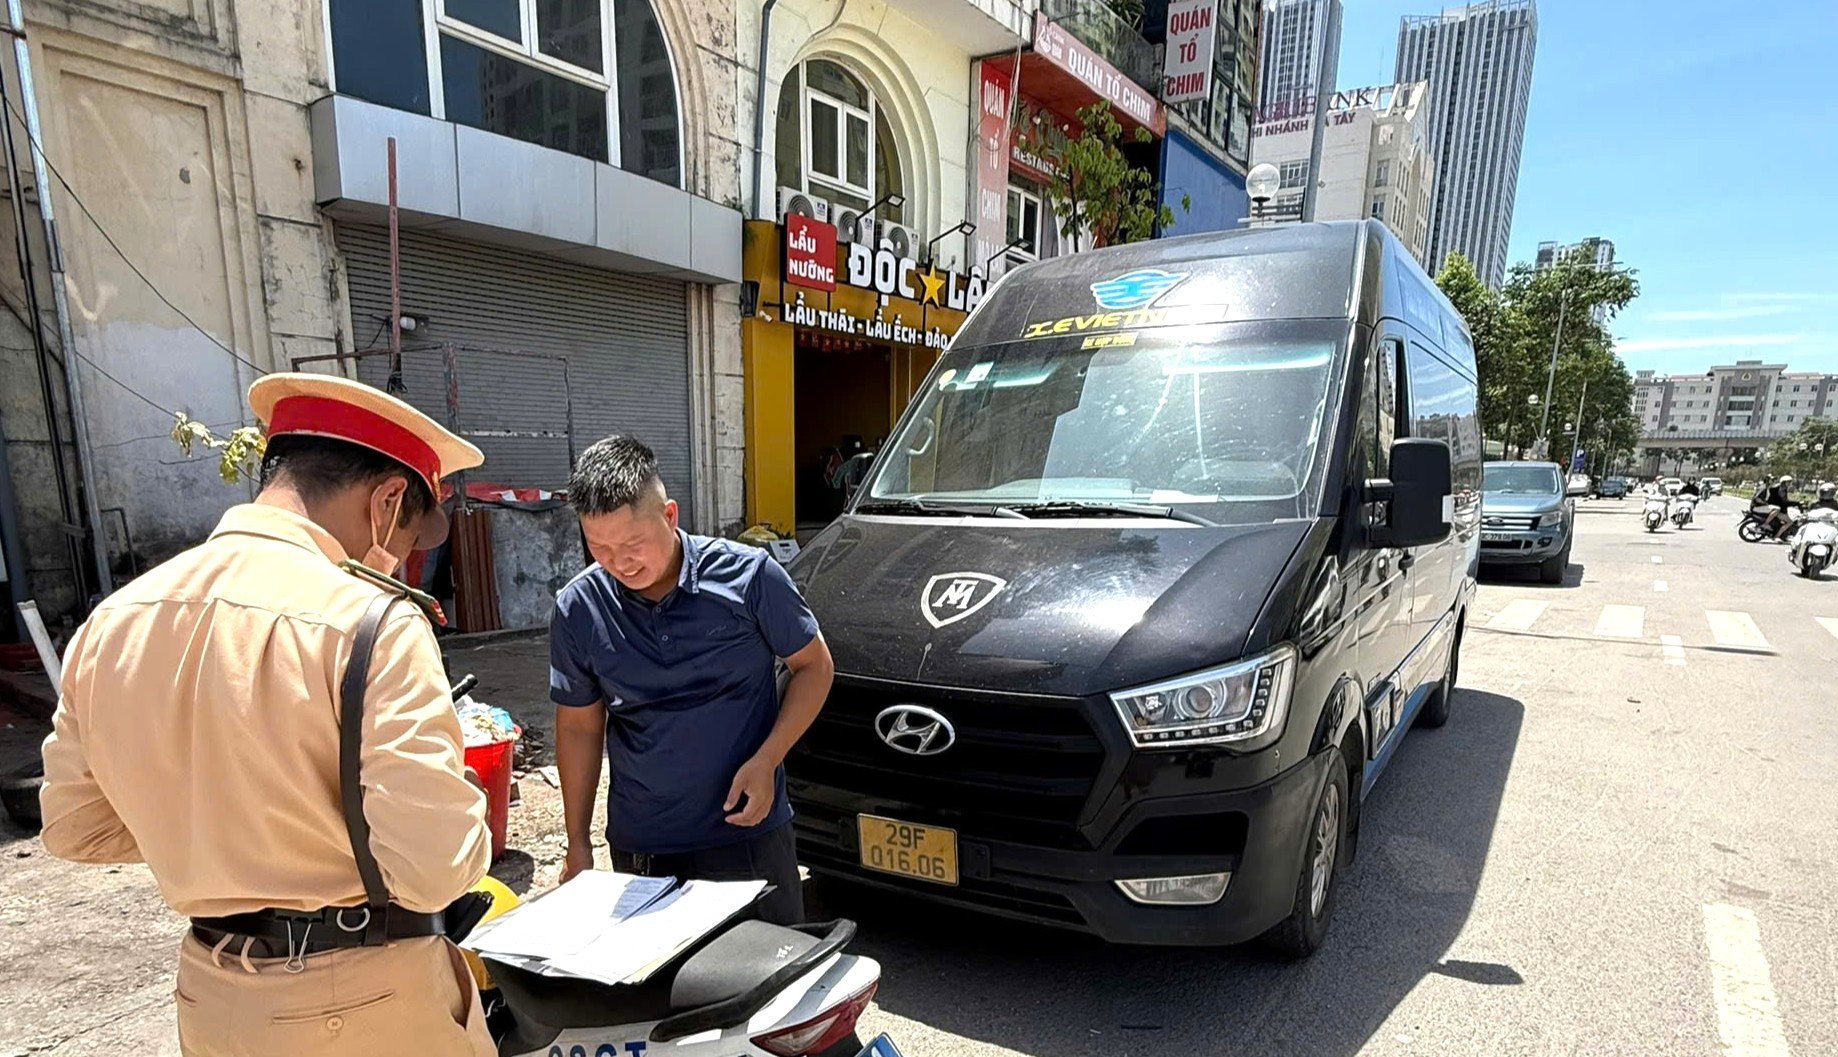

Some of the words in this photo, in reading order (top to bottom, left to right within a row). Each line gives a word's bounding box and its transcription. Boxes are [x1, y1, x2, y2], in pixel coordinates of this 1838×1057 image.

[1170, 5, 1212, 36] QUÁN
[1179, 33, 1199, 63] TỔ
[984, 79, 1005, 119] QUÁN
[1068, 46, 1103, 88] QUÁN
[1106, 73, 1122, 100] TỔ
[1122, 89, 1151, 122] CHIM
[1166, 72, 1205, 97] CHIM
[1251, 127, 1262, 138] HI
[1265, 119, 1309, 137] NHÁNH
[1334, 111, 1356, 126] TÂY
[989, 128, 999, 170] TỔ
[1013, 146, 1070, 181] RESTAUR
[981, 188, 1001, 222] CHIM
[788, 226, 816, 253] LẨU
[848, 238, 916, 306] ĐỘC
[947, 265, 992, 313] LÂ
[784, 291, 816, 327] LẨU
[818, 308, 856, 334] THÁI
[865, 308, 892, 340] LẨU
[893, 313, 917, 345] ẾCH
[1576, 449, 1585, 458] P
[885, 823, 926, 850] 29F
[870, 845, 946, 879] 016.06
